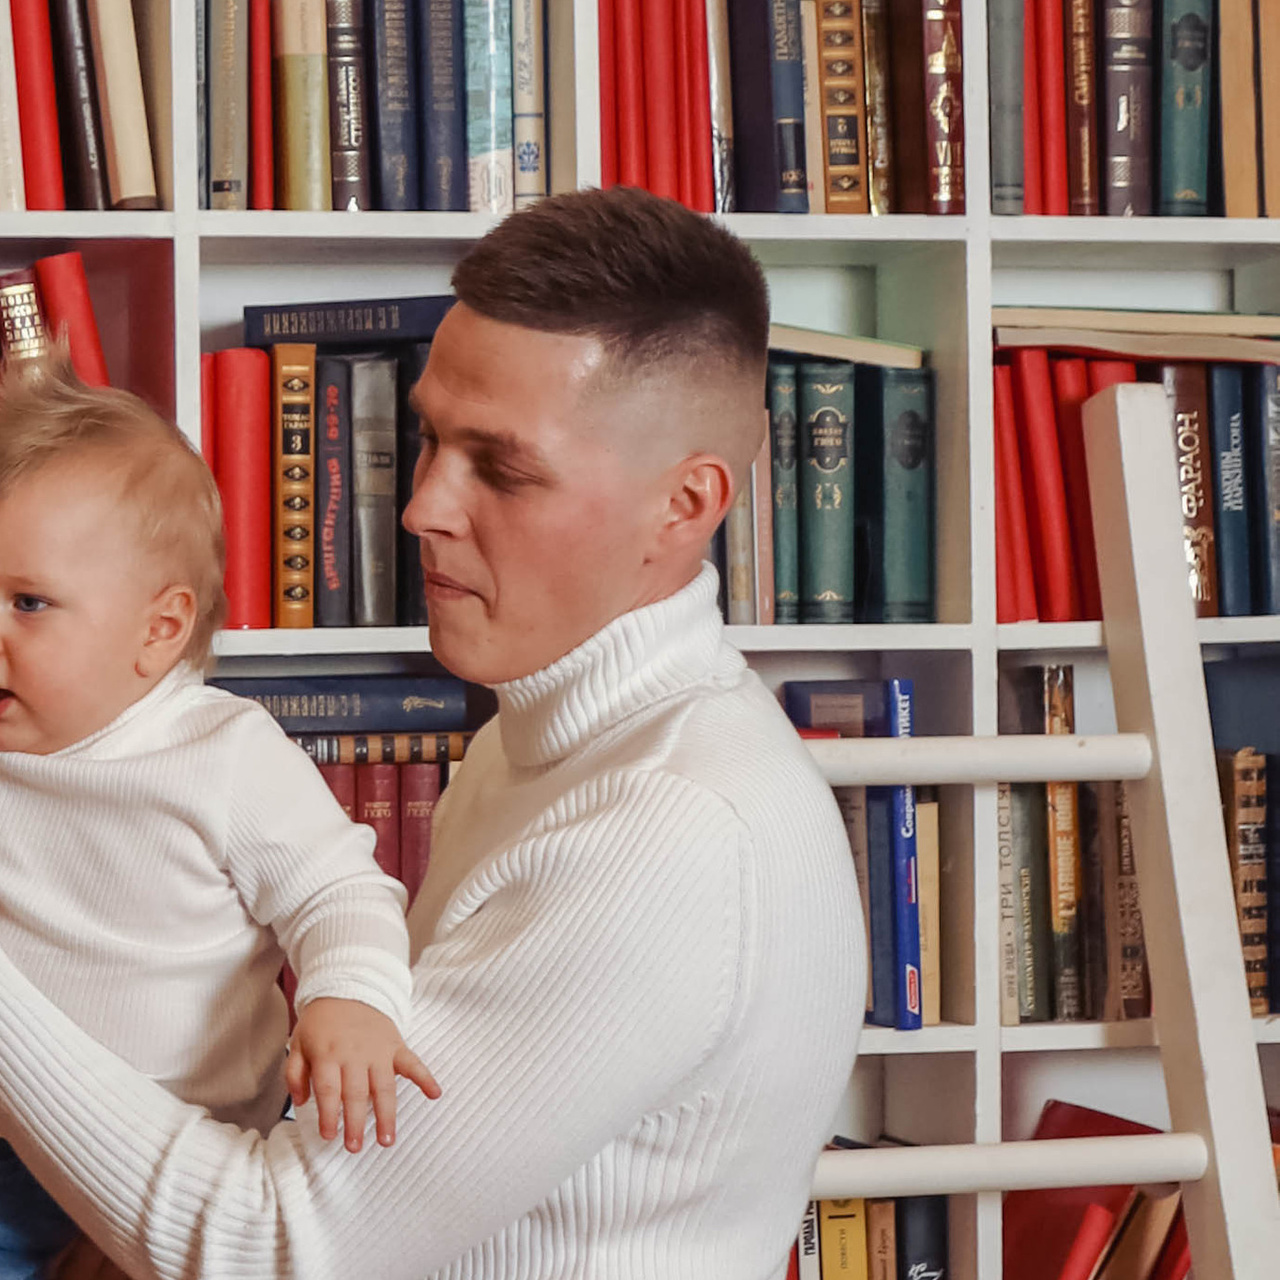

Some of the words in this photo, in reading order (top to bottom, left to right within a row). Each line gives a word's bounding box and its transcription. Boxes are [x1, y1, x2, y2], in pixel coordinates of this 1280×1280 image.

[348, 65, 362, 147] СТИВЕНСОН
[291, 435, 302, 450] 3
[327, 385, 339, 440] 69-70
[1177, 411, 1203, 519] ФАРАОН
[322, 458, 342, 590] БРИГАНТИНА
[1054, 783, 1072, 832] NOIRE
[1001, 885, 1012, 923] ТРИ
[1058, 837, 1077, 917] L'AFRIQUE
